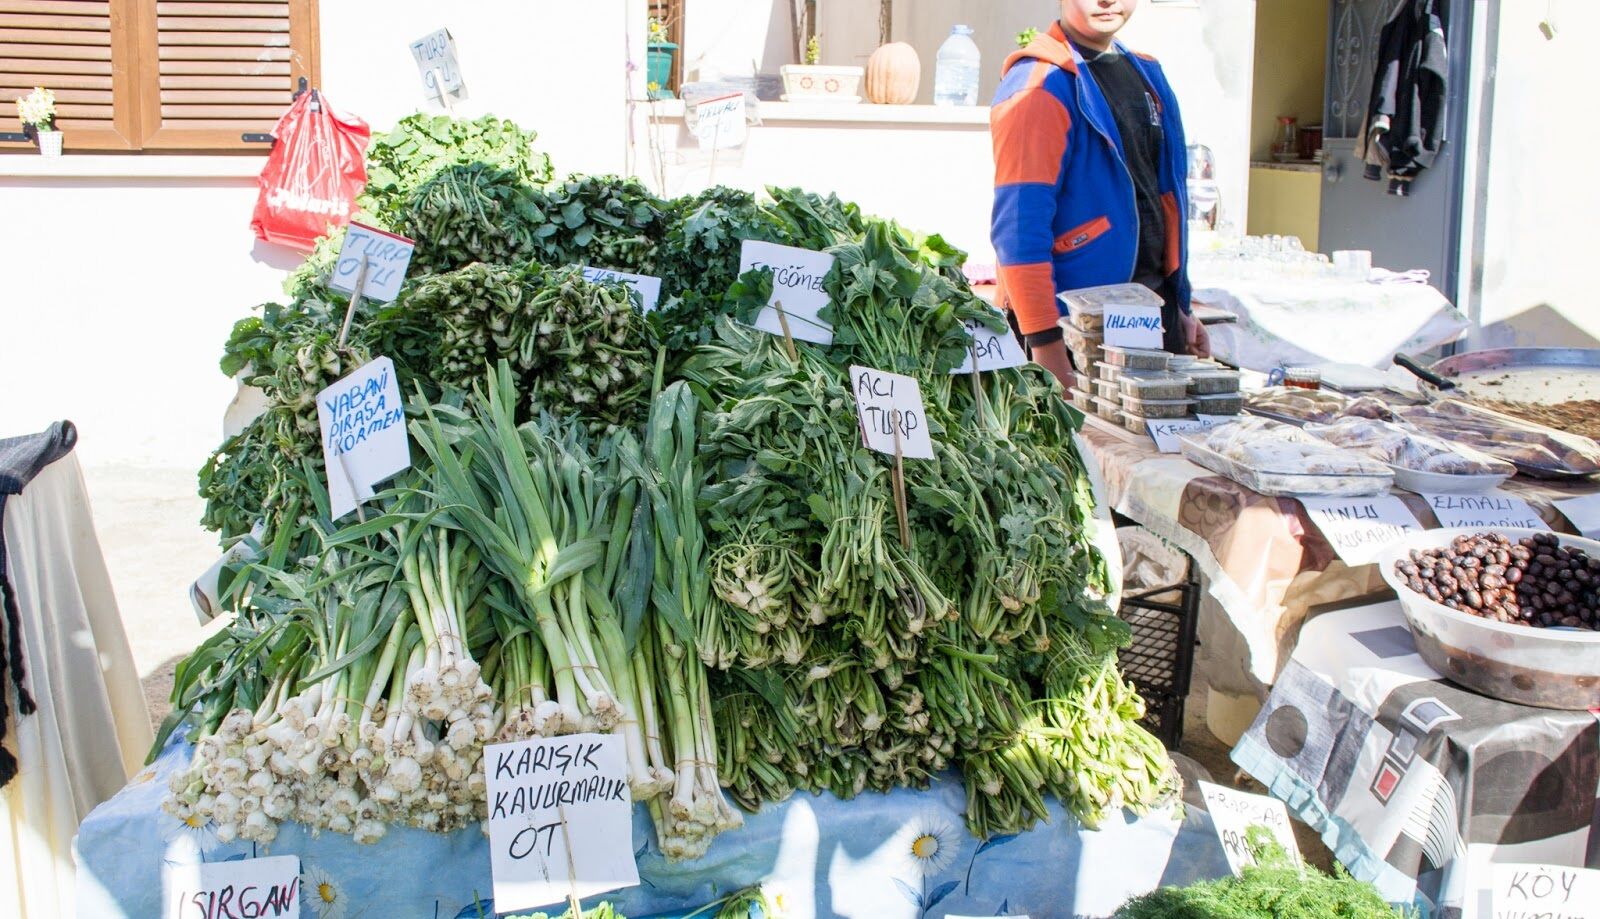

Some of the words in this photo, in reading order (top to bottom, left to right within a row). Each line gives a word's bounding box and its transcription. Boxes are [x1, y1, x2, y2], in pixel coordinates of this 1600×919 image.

[348, 232, 411, 262] TURP
[1106, 313, 1161, 331] IHLAMUR
[858, 371, 894, 399] ACI
[328, 394, 386, 448] PIRASA
[864, 406, 918, 440] TURP
[1321, 504, 1379, 522] UNLU
[1433, 496, 1513, 510] ELMALI
[495, 743, 603, 780] KARIŞIK
[491, 775, 626, 820] KAVURMALIK
[509, 820, 568, 860] OT
[1507, 866, 1577, 903] KÖY
